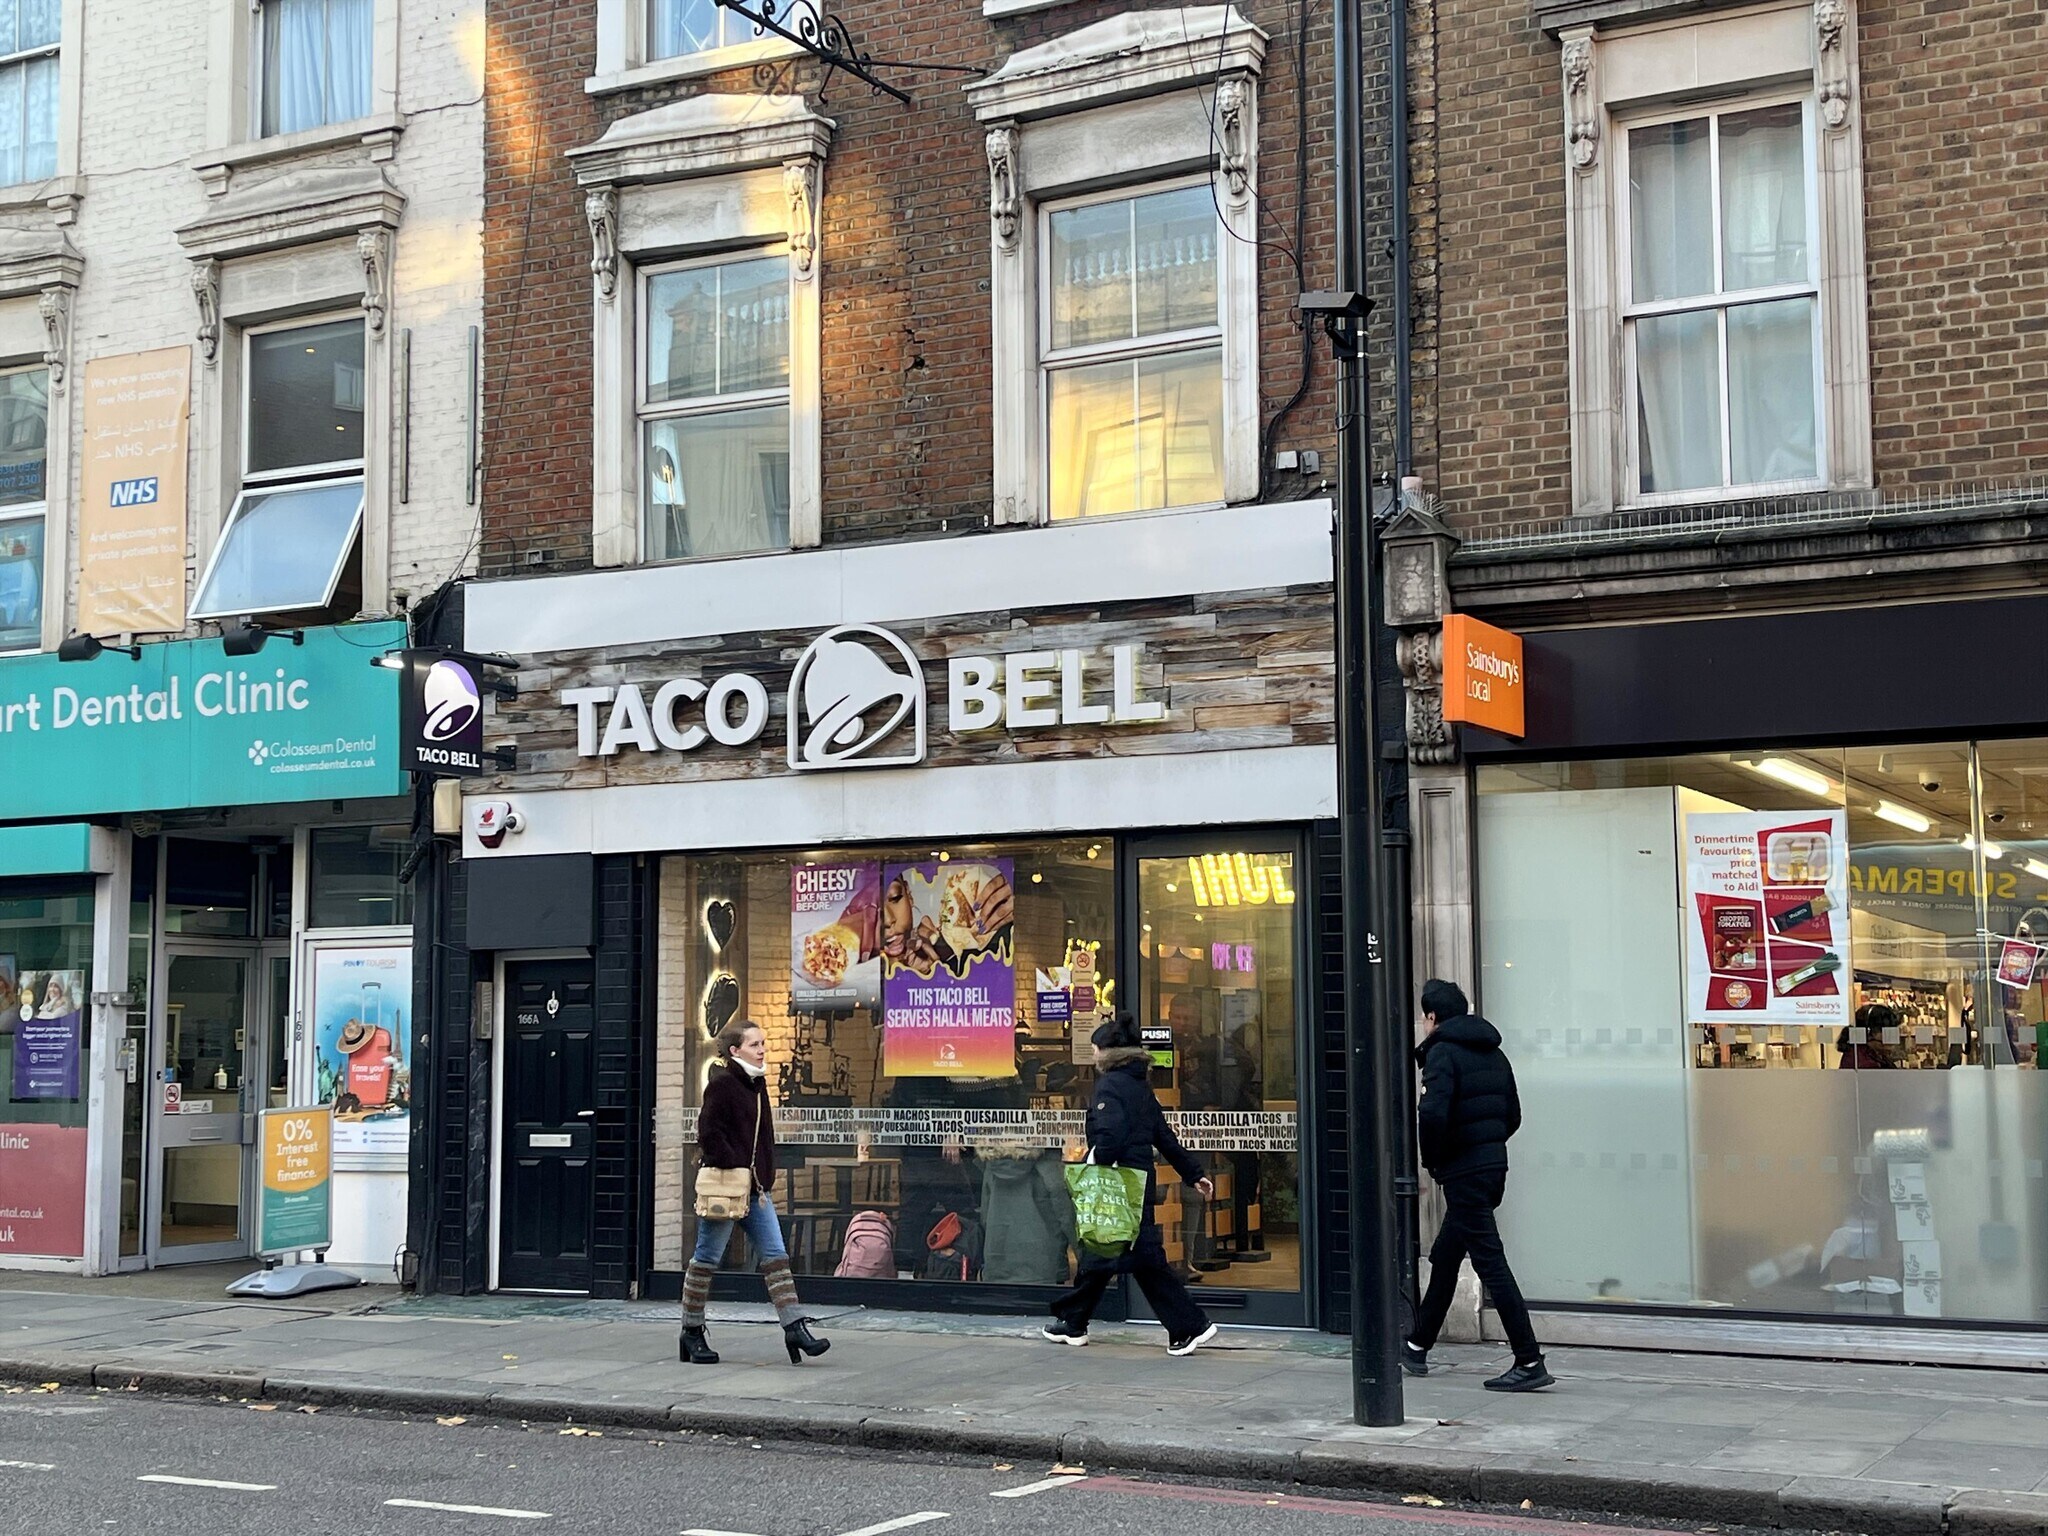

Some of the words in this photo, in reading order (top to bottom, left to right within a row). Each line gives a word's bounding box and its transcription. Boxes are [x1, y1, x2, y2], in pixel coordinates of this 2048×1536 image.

[117, 390, 137, 403] NHS
[115, 442, 143, 458] NHS
[112, 479, 156, 506] NHS
[1467, 642, 1519, 686] Sainsbury's
[1467, 674, 1491, 702] Local
[53, 676, 182, 729] Dental
[194, 668, 309, 717] Clinic
[560, 672, 769, 757] TACO
[948, 645, 1166, 733] BELL
[270, 740, 333, 758] Colosseum
[336, 734, 376, 753] Dental
[416, 746, 449, 764] TACO
[450, 750, 480, 768] BELL
[270, 757, 376, 774] colosseumdental.co.uk
[1694, 835, 1754, 844] Dinnertime
[1730, 859, 1756, 869] price
[796, 868, 857, 893] CHEESY
[1712, 870, 1758, 879] matched
[1724, 883, 1735, 891] to
[1737, 882, 1759, 891] Aldi
[796, 893, 815, 903] LIKE
[816, 891, 846, 902] NEVER
[796, 902, 832, 911] BEFORE.
[907, 988, 933, 1006] THIS
[933, 987, 962, 1006] TACO
[965, 987, 990, 1005] BELL
[1796, 1001, 1840, 1010] Sainsbury's
[517, 1014, 540, 1024] 166A
[887, 1008, 930, 1028] SERVES
[932, 1008, 971, 1027] HALAL
[971, 1007, 1012, 1027] MEATS
[1141, 1030, 1170, 1039] PUSH
[352, 1065, 368, 1073] Ease
[369, 1065, 385, 1074] your
[828, 1109, 854, 1119] TACOS
[859, 1110, 890, 1119] BURRITO
[893, 1110, 930, 1121] NACHOS
[931, 1111, 962, 1119] BURRITO
[964, 1111, 1028, 1124] QUESADILLA
[1031, 1111, 1058, 1120] TACOS
[1181, 1113, 1250, 1127] QUESADILLA
[1252, 1113, 1281, 1124] TACOS
[283, 1119, 313, 1141] 0%
[885, 1122, 931, 1132] QUESADILLA
[932, 1121, 963, 1133] TACOS
[1225, 1128, 1257, 1138] BURRITO
[783, 1134, 814, 1142] BURRITO
[816, 1134, 840, 1142] TACOS
[843, 1134, 879, 1143] NAOS
[904, 1134, 965, 1145] QUESADILLA
[1200, 1140, 1235, 1149] BURRITO
[1239, 1140, 1265, 1150] TACOS
[276, 1142, 319, 1156] Interest
[287, 1156, 309, 1168] free
[277, 1169, 317, 1182] finance.
